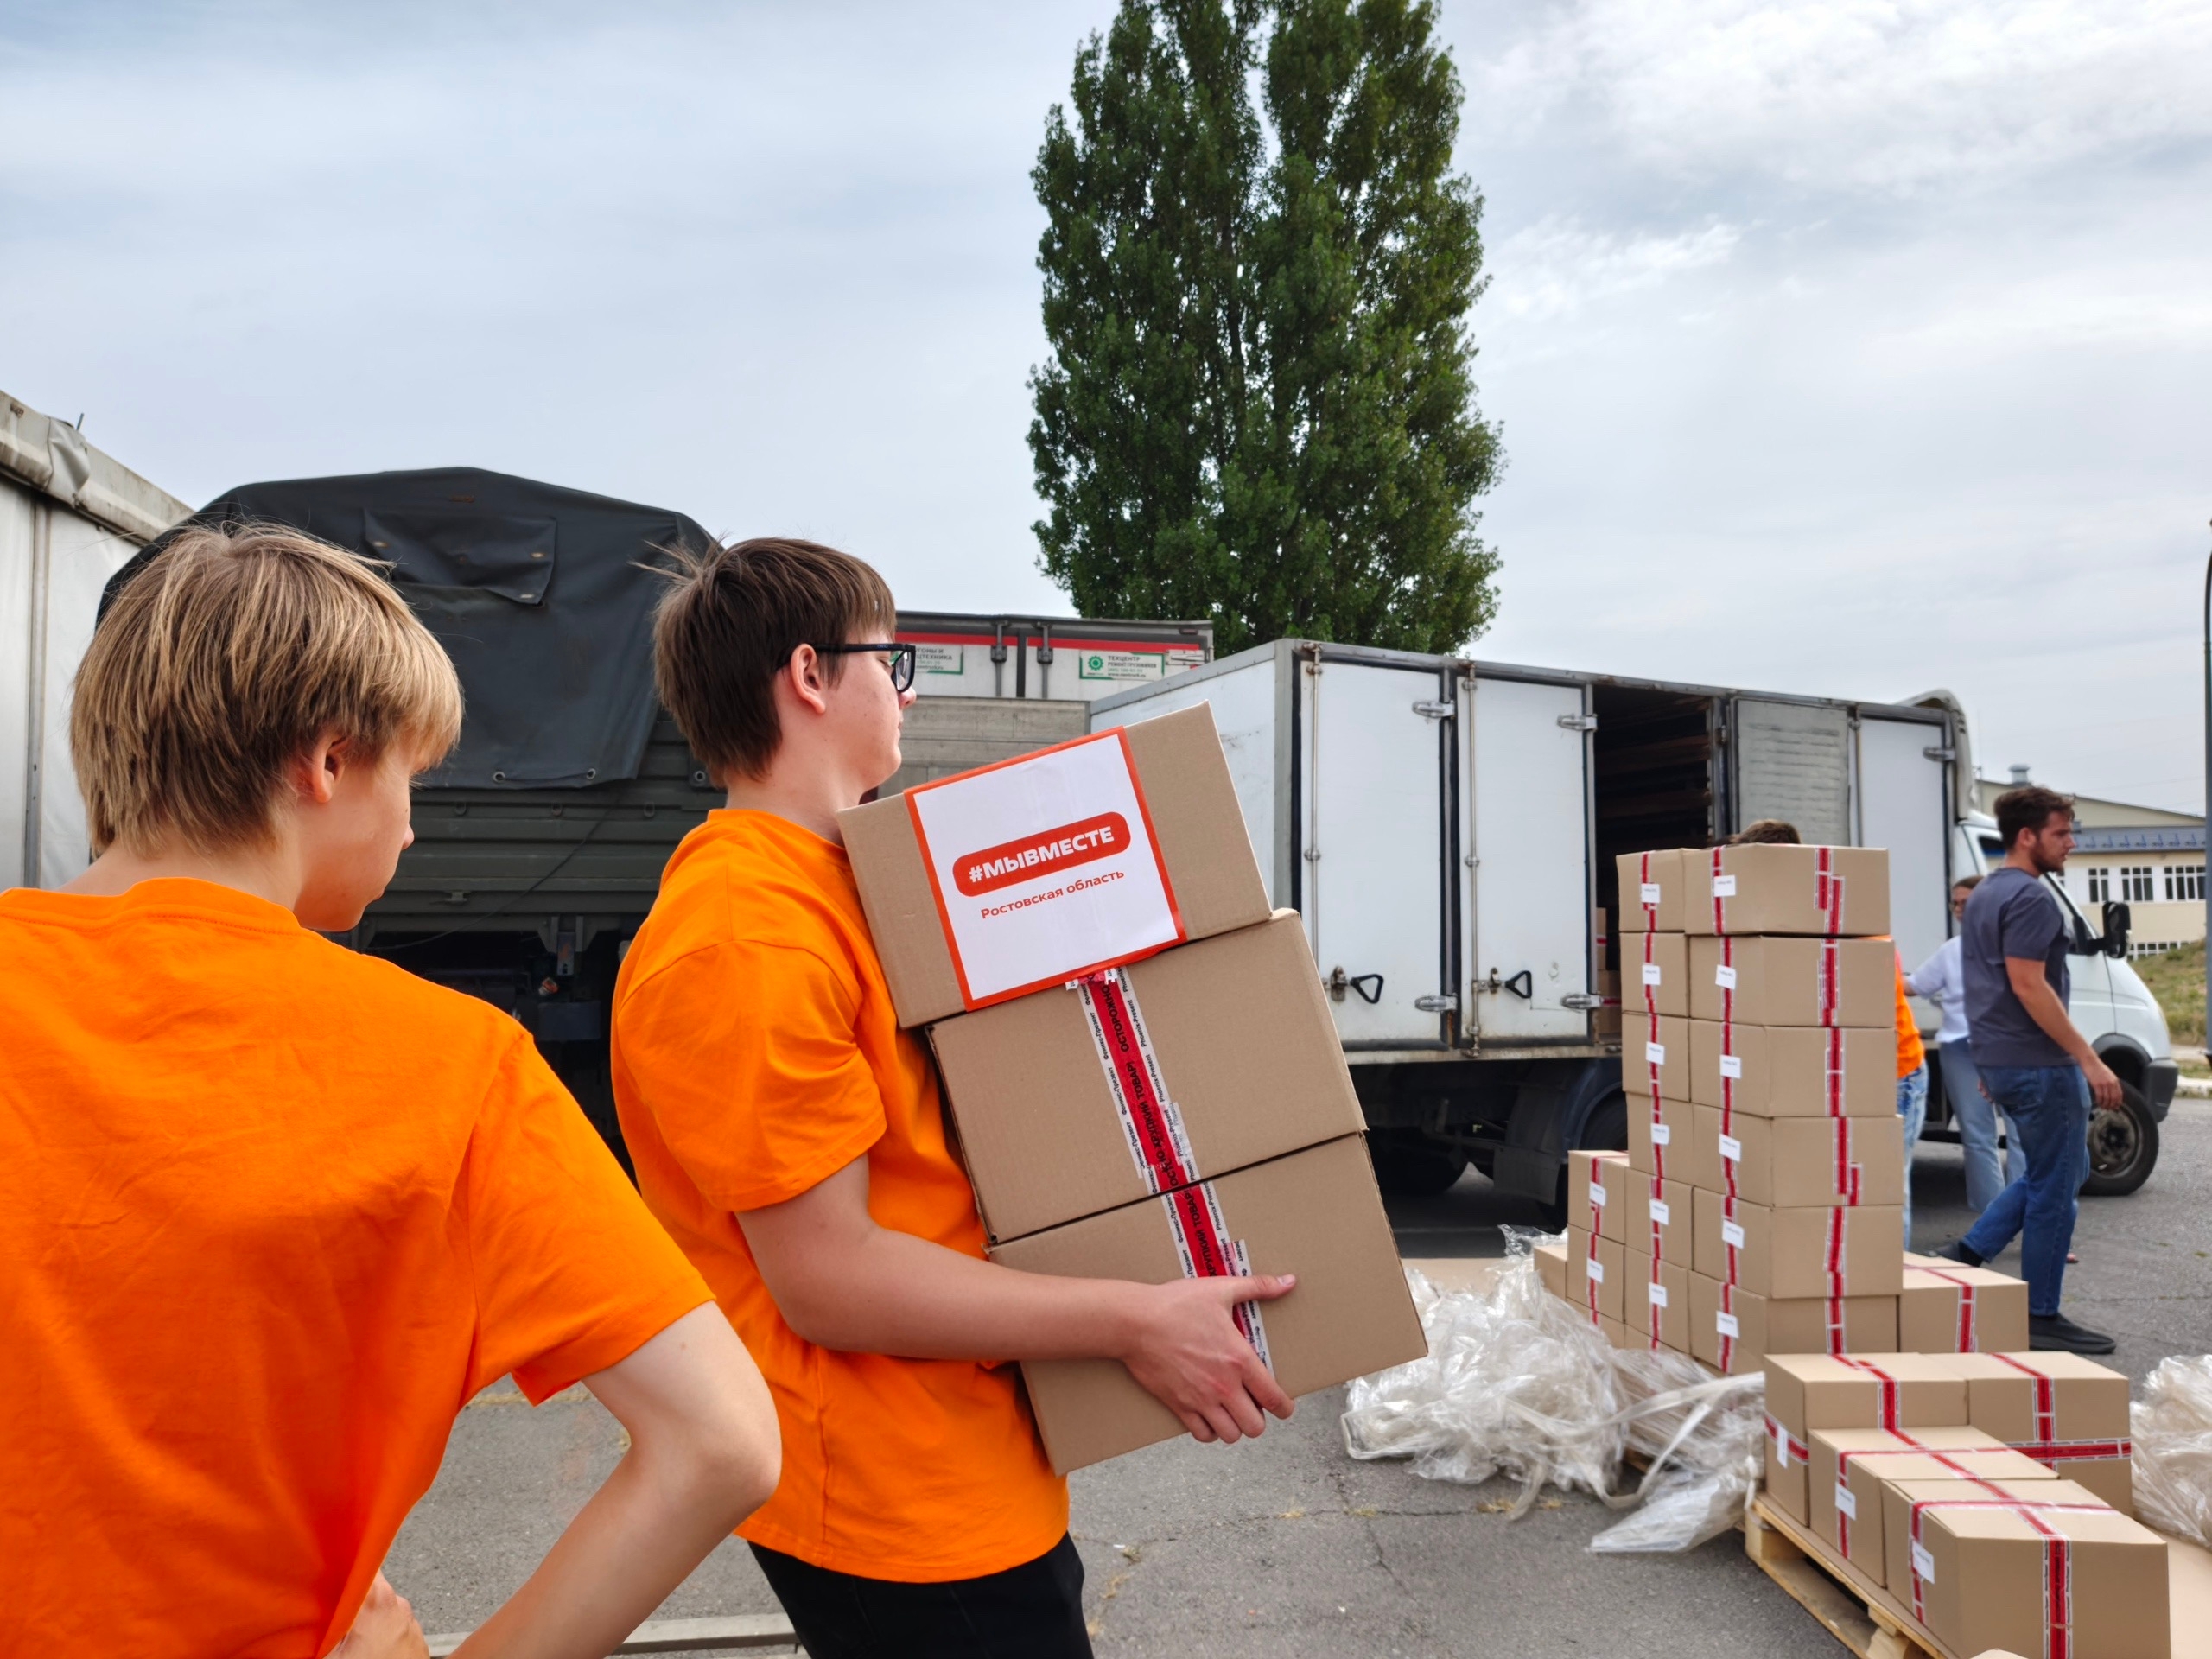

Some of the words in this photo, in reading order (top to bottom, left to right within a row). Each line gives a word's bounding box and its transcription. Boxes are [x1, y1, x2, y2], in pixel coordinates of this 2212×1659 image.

[969, 826, 1115, 883] #МЫВМЕСТЕ
[981, 887, 1064, 919] Ростовская
[1066, 868, 1125, 894] область
[1089, 1011, 1109, 1060] Феникс-Презент
[1099, 983, 1130, 1052] ОСТОРОЖНО
[1126, 998, 1147, 1047] Phoenix-Present
[1107, 1065, 1128, 1115] Феникс-Презент
[1125, 1060, 1145, 1099] ТОВАР!
[1144, 1053, 1166, 1103] Phoenix-Present
[1137, 1100, 1162, 1149] ХРУПКИЙ
[1162, 1109, 1184, 1157] Phoenix-Present
[1163, 1193, 1185, 1243] Феникс-Презент
[1201, 1181, 1223, 1230] Phoenix-Present
